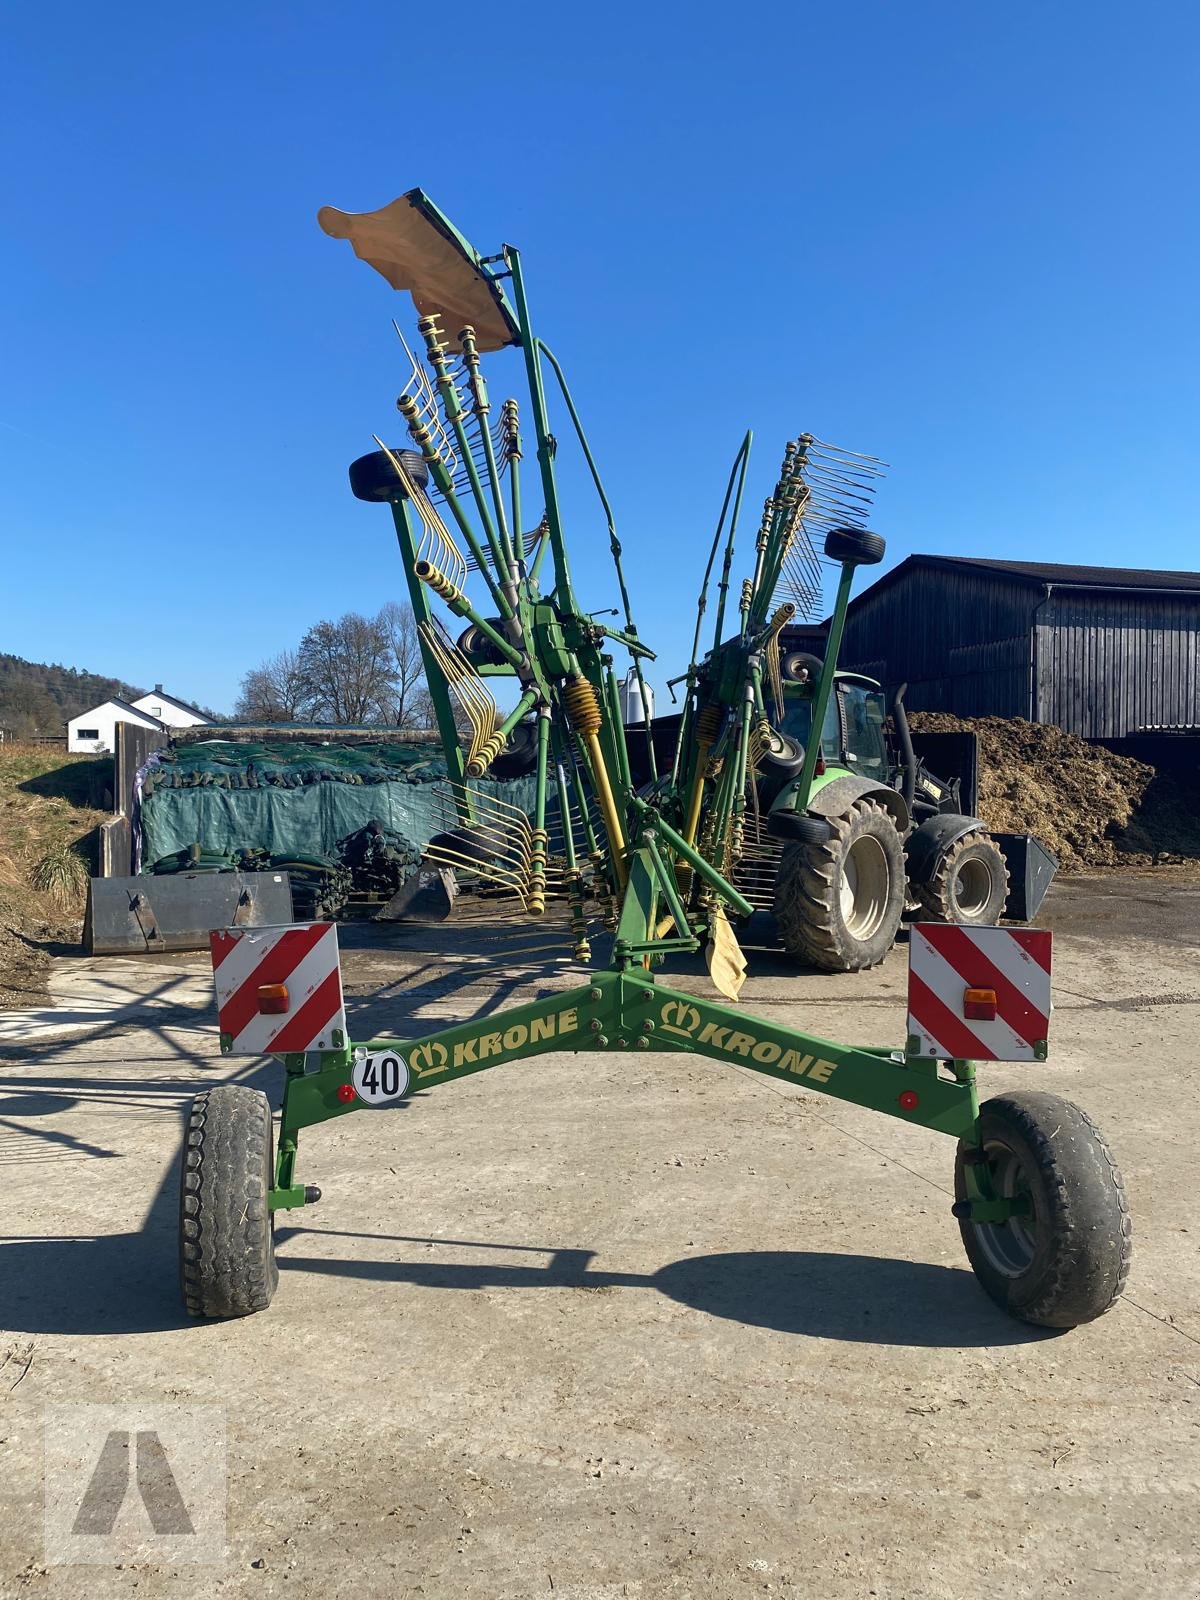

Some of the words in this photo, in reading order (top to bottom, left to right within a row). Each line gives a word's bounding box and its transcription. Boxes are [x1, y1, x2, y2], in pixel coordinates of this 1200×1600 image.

[453, 1007, 578, 1068] KRONE
[697, 1022, 839, 1083] KRONE
[361, 1057, 400, 1096] 40
